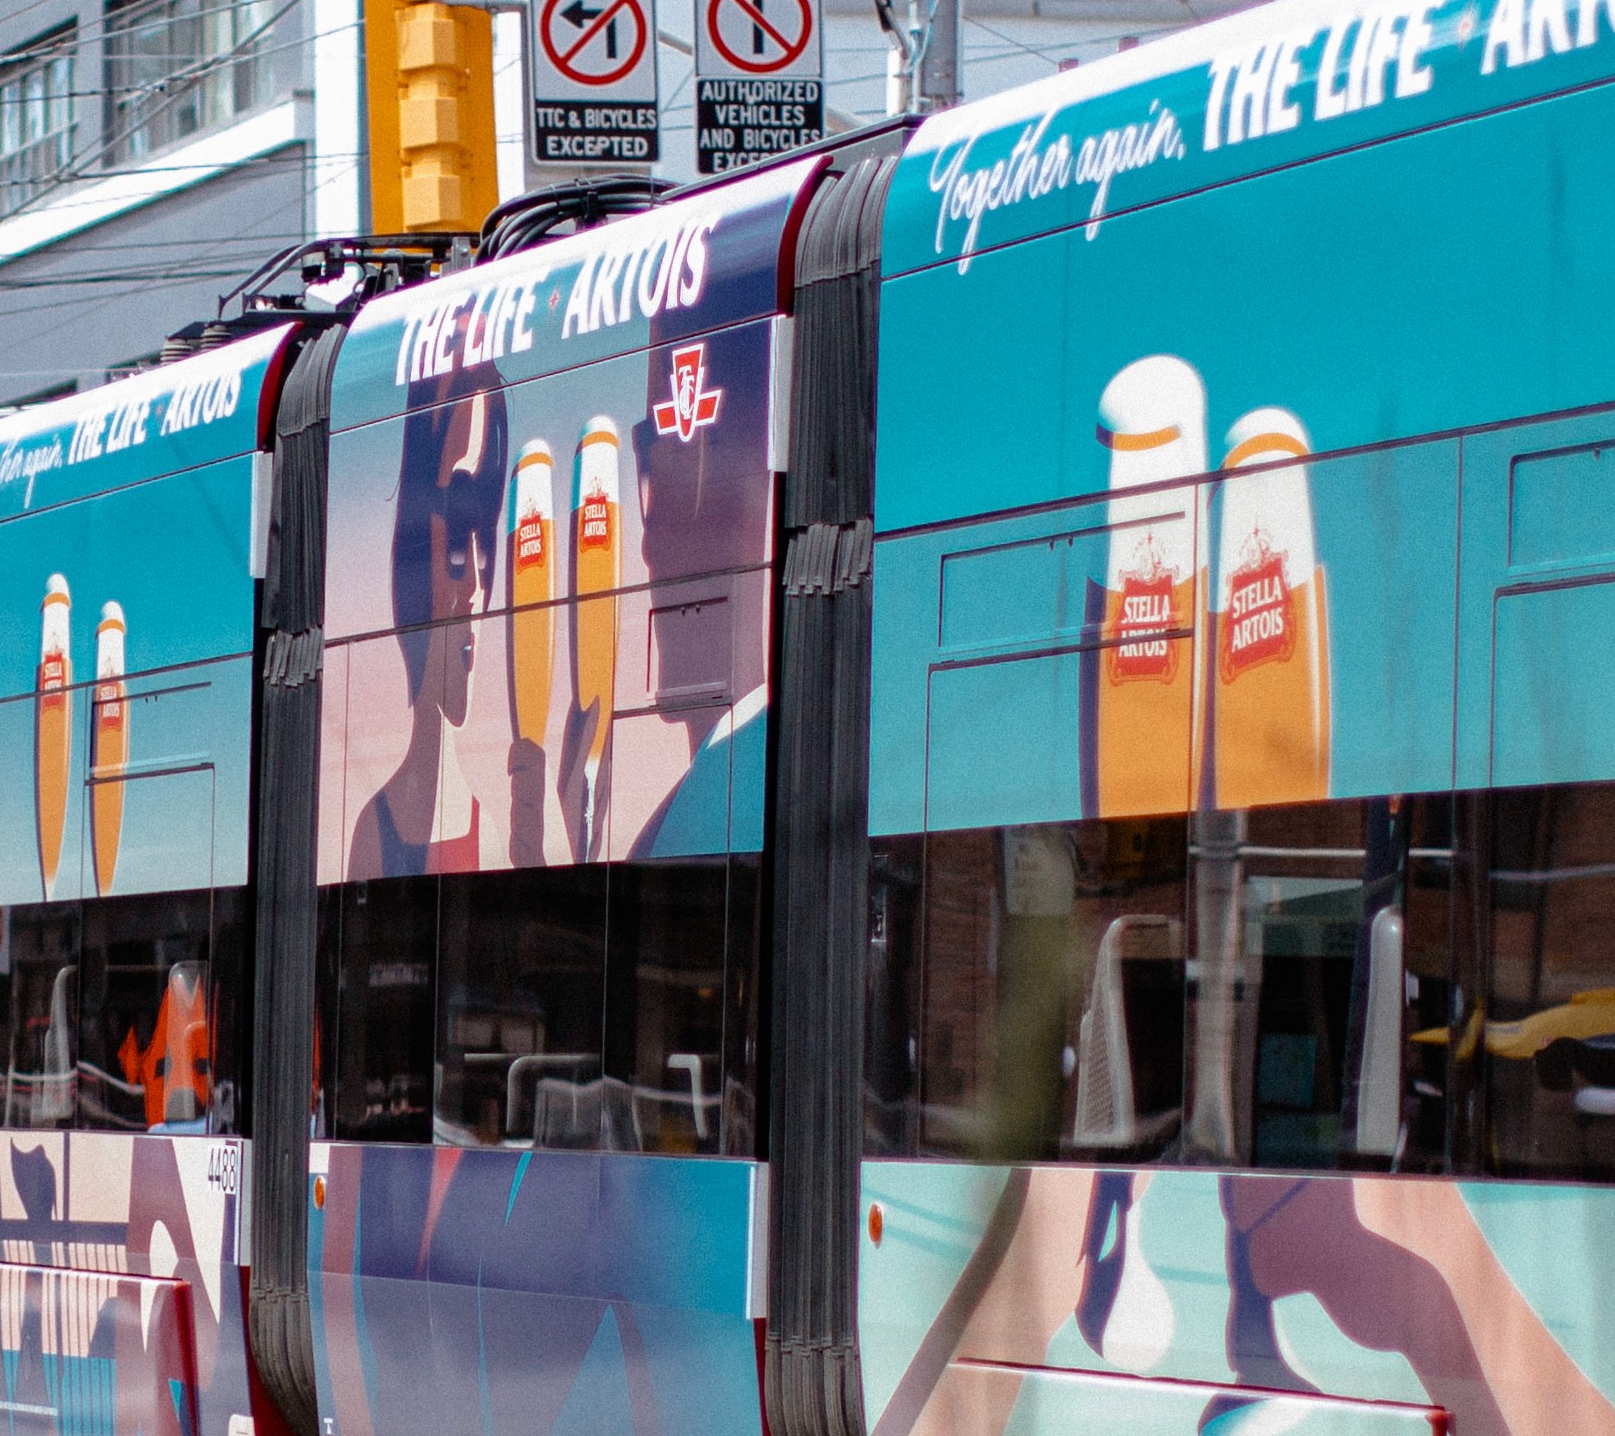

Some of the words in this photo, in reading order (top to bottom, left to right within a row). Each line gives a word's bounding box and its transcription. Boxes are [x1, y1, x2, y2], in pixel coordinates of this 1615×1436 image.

[701, 81, 818, 103] AUTHORIZED
[537, 108, 565, 128] TTC
[569, 110, 581, 128] &
[585, 109, 657, 129] BICYCLES
[715, 105, 805, 126] VEHICLES
[547, 136, 648, 157] EXCEPTED
[700, 128, 735, 149] AND
[929, 102, 1069, 275] Together
[1202, 48, 1307, 152] THE
[395, 292, 469, 387] THE
[462, 266, 550, 368] LIFE
[561, 219, 715, 340] ARTOIS
[67, 418, 110, 465] THE
[105, 400, 152, 454] LIFE
[160, 370, 243, 437] ARTOIS
[1121, 595, 1170, 624] STELLA
[1232, 576, 1283, 619] STELLA
[1231, 607, 1284, 654] ARTOIS
[207, 1148, 236, 1192] 4488
